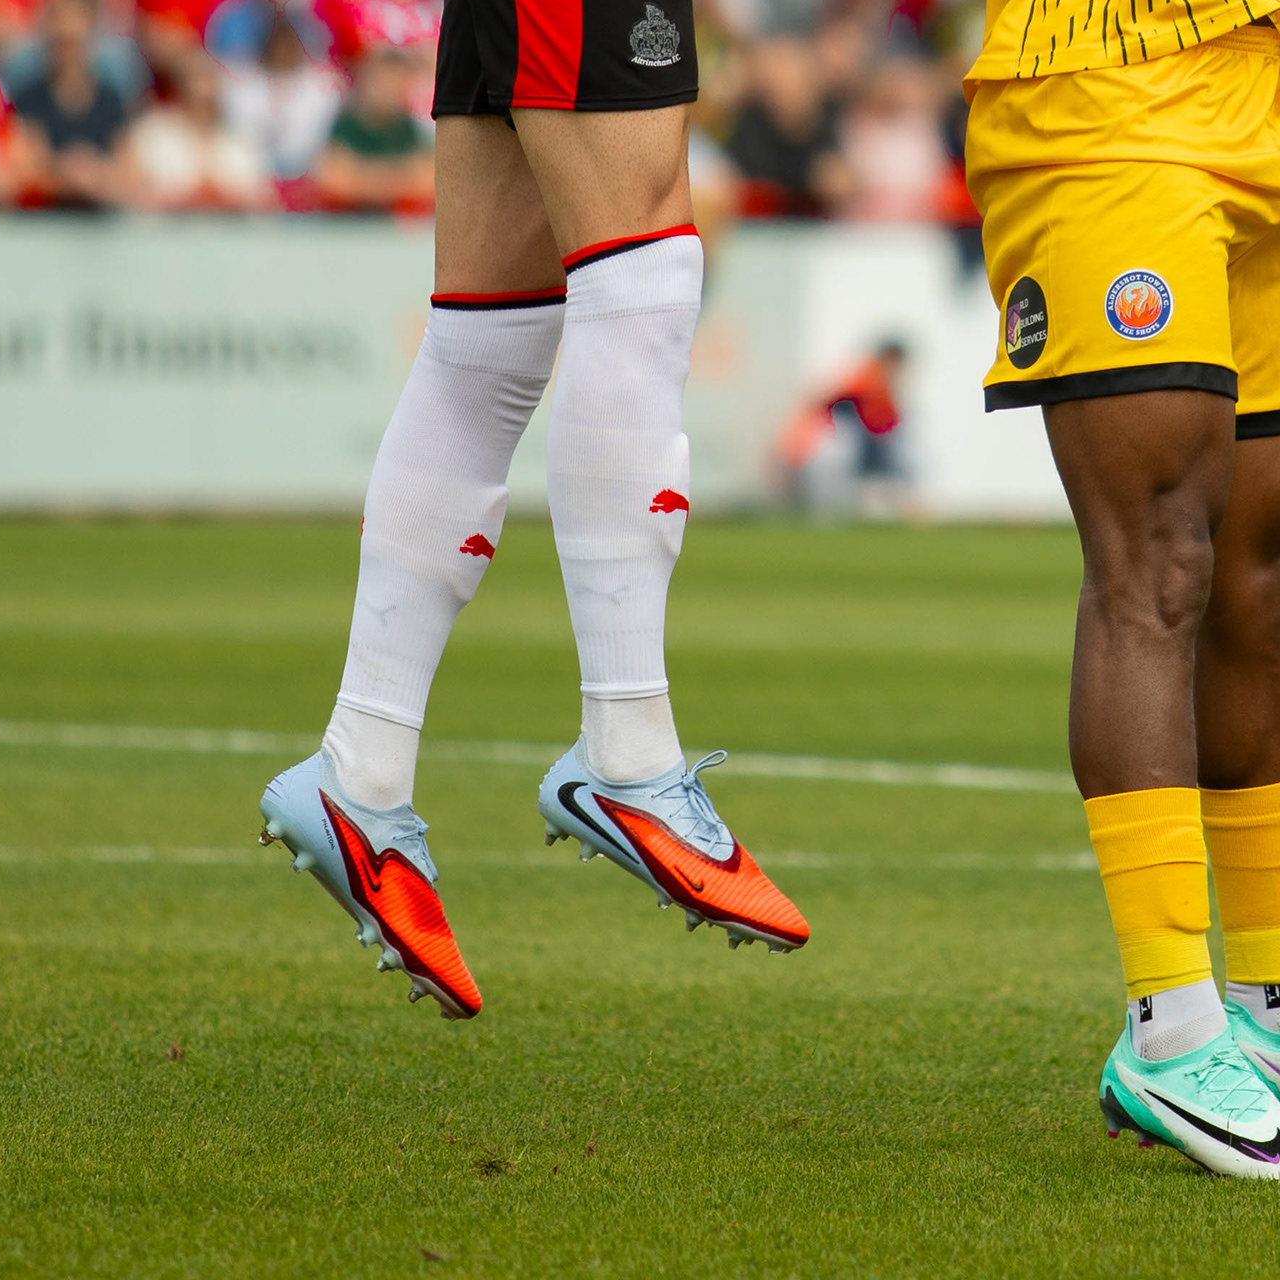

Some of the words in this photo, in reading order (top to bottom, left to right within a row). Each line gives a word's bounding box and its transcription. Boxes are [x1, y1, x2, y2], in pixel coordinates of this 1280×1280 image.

[631, 55, 673, 67] Altrincham
[1108, 274, 1141, 311] ALDERSHOT
[1142, 275, 1165, 292] TOWN
[1020, 311, 1044, 329] BUILDING
[1119, 324, 1135, 335] THE
[1135, 322, 1160, 336] SHOTS
[1020, 330, 1047, 348] SERVICES
